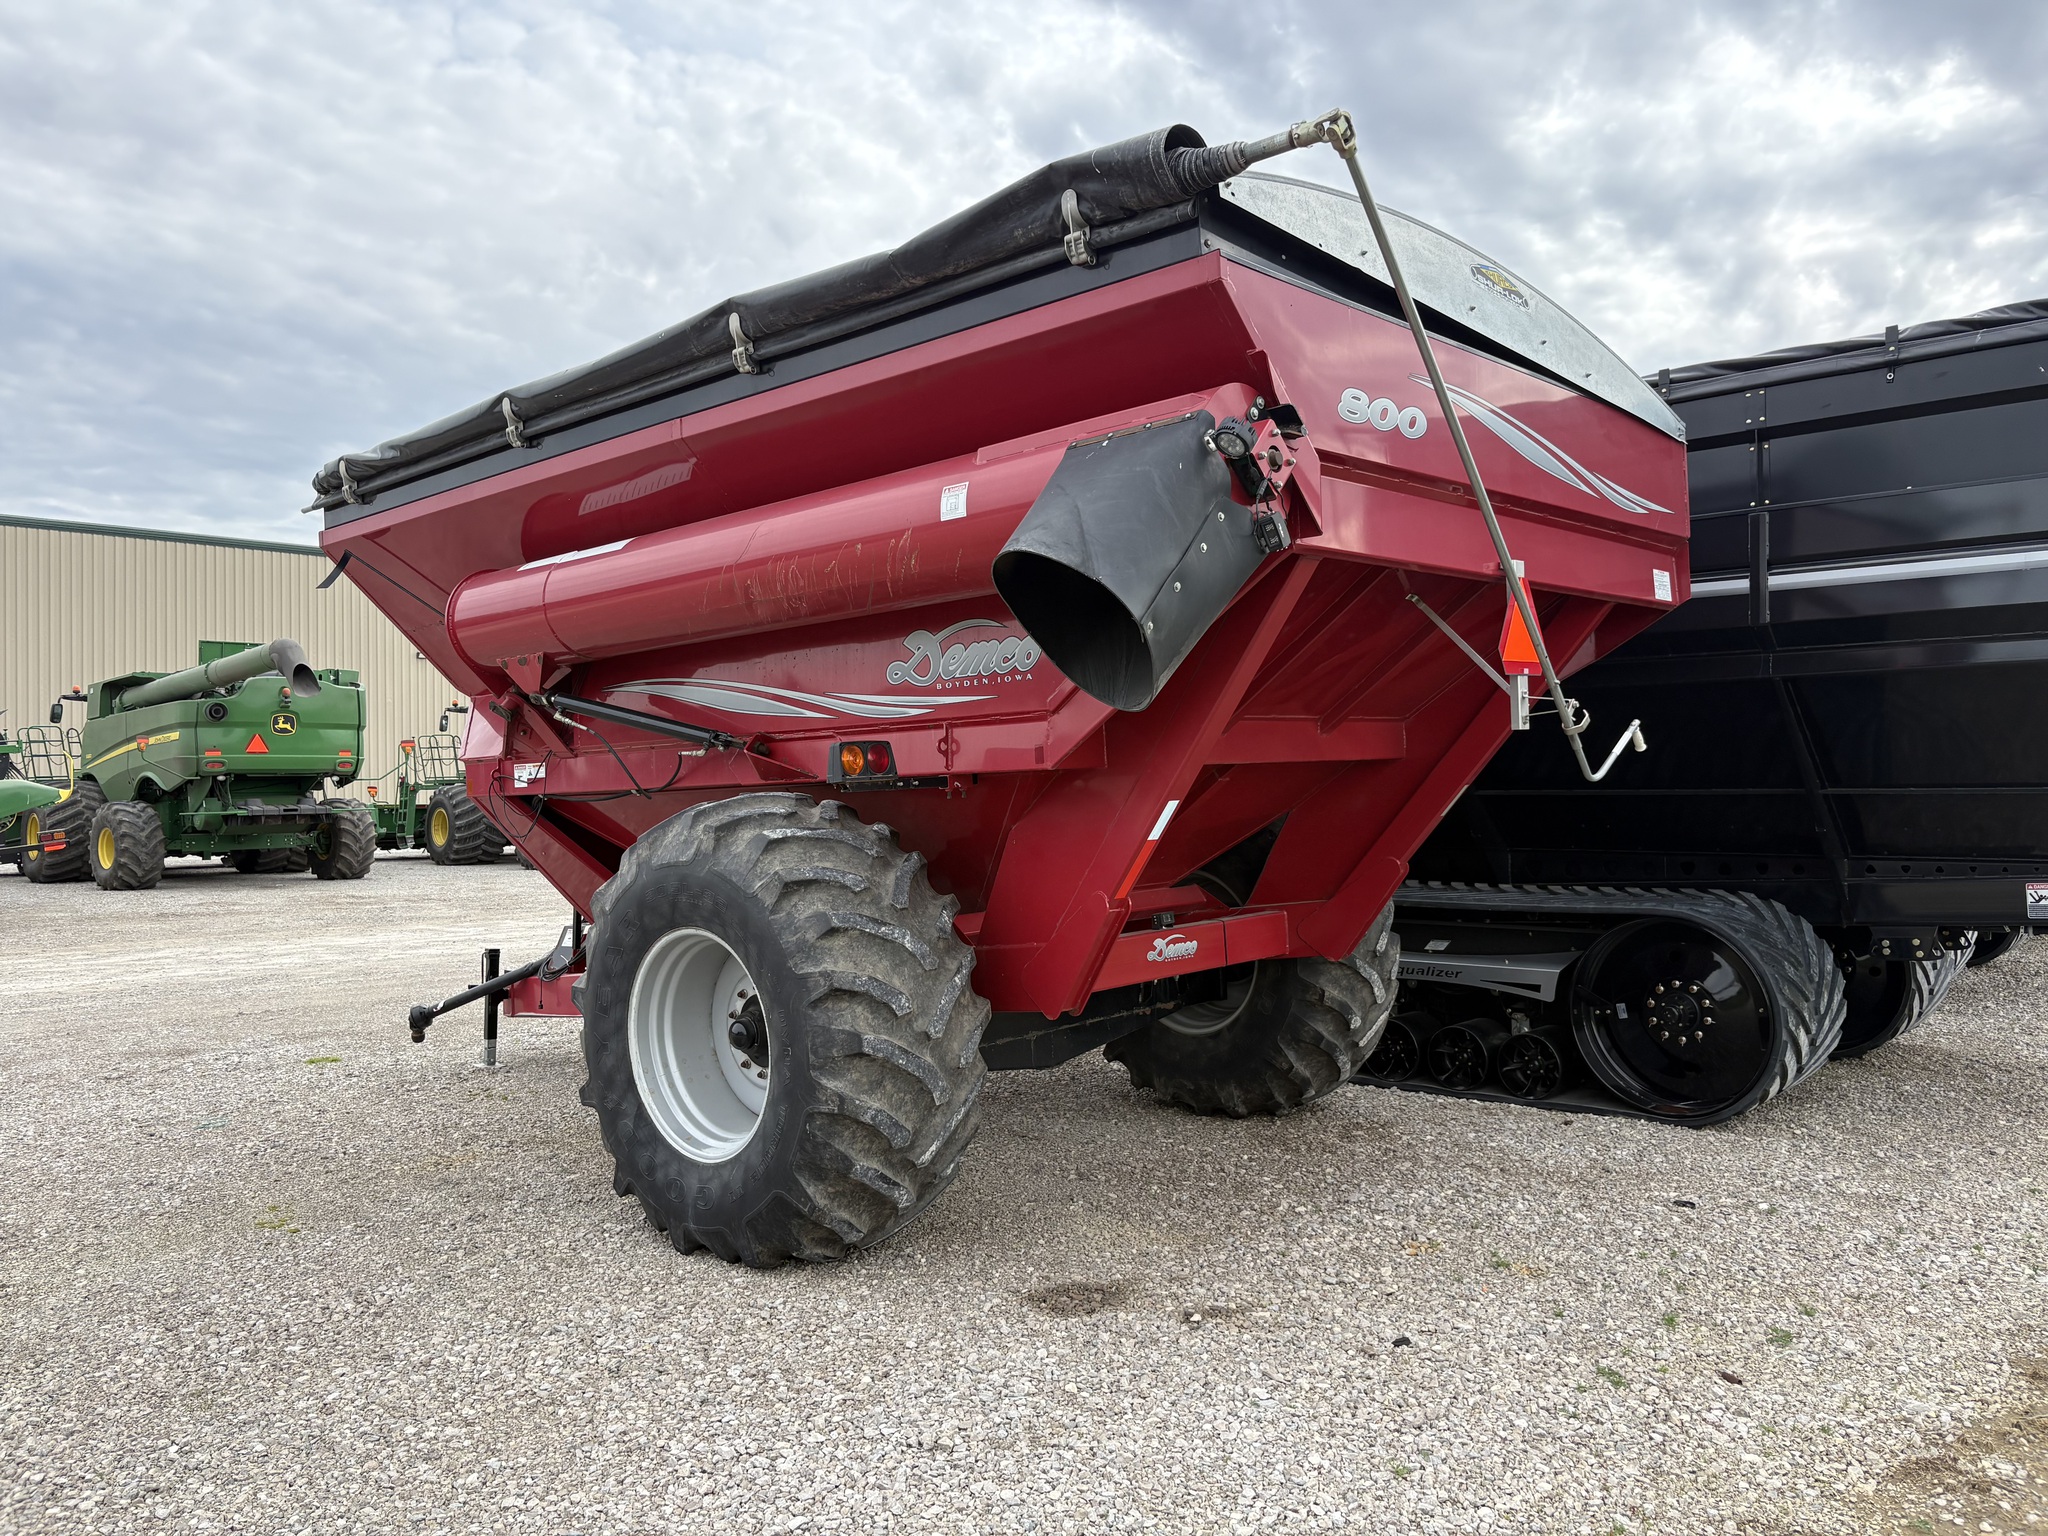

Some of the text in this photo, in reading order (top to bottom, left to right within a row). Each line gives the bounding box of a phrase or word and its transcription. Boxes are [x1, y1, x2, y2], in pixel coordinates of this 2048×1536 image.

[1337, 387, 1428, 440] 800
[886, 618, 1043, 687] Demco
[1146, 933, 1198, 962] Demco
[1396, 966, 1463, 979] qualizer
